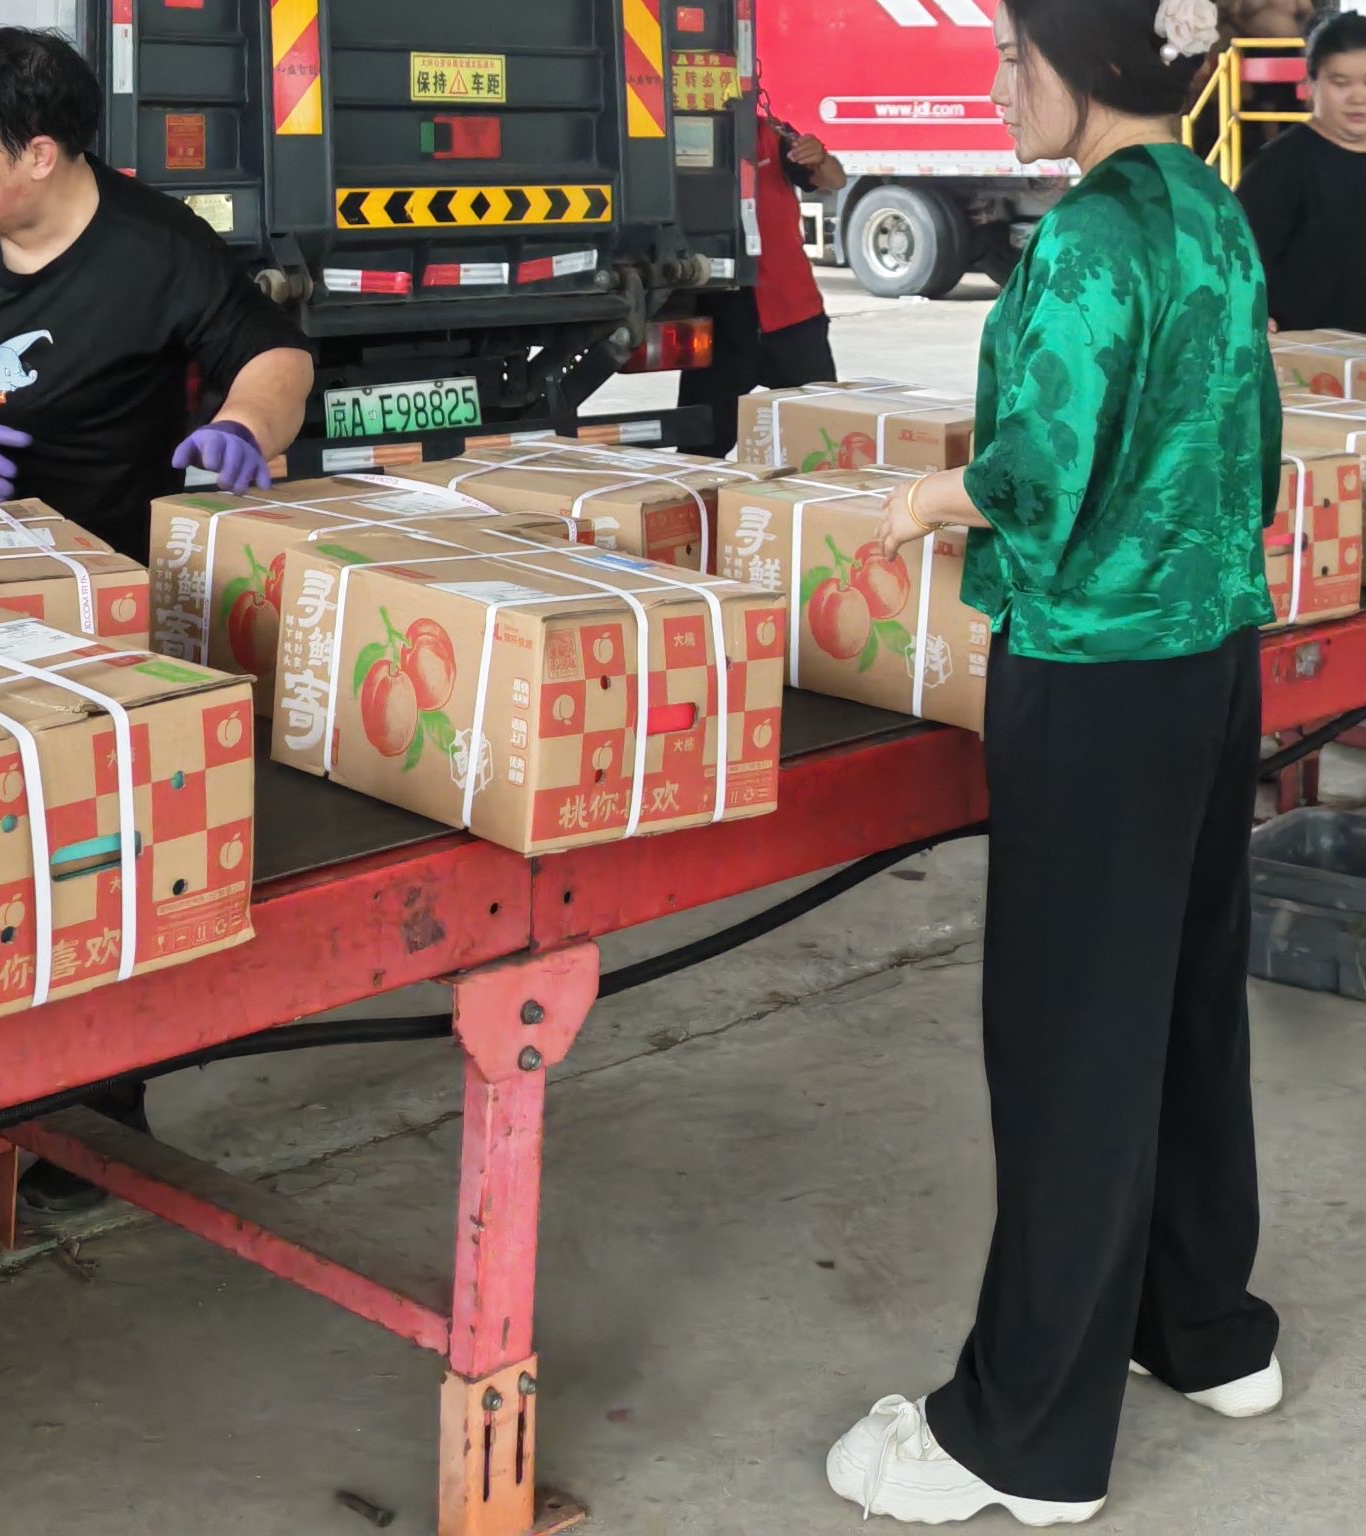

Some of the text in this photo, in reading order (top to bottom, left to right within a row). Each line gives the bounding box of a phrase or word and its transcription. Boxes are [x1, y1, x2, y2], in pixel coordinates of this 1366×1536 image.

[417, 70, 500, 95] 保持 车距
[875, 101, 965, 120] www.jdl.com
